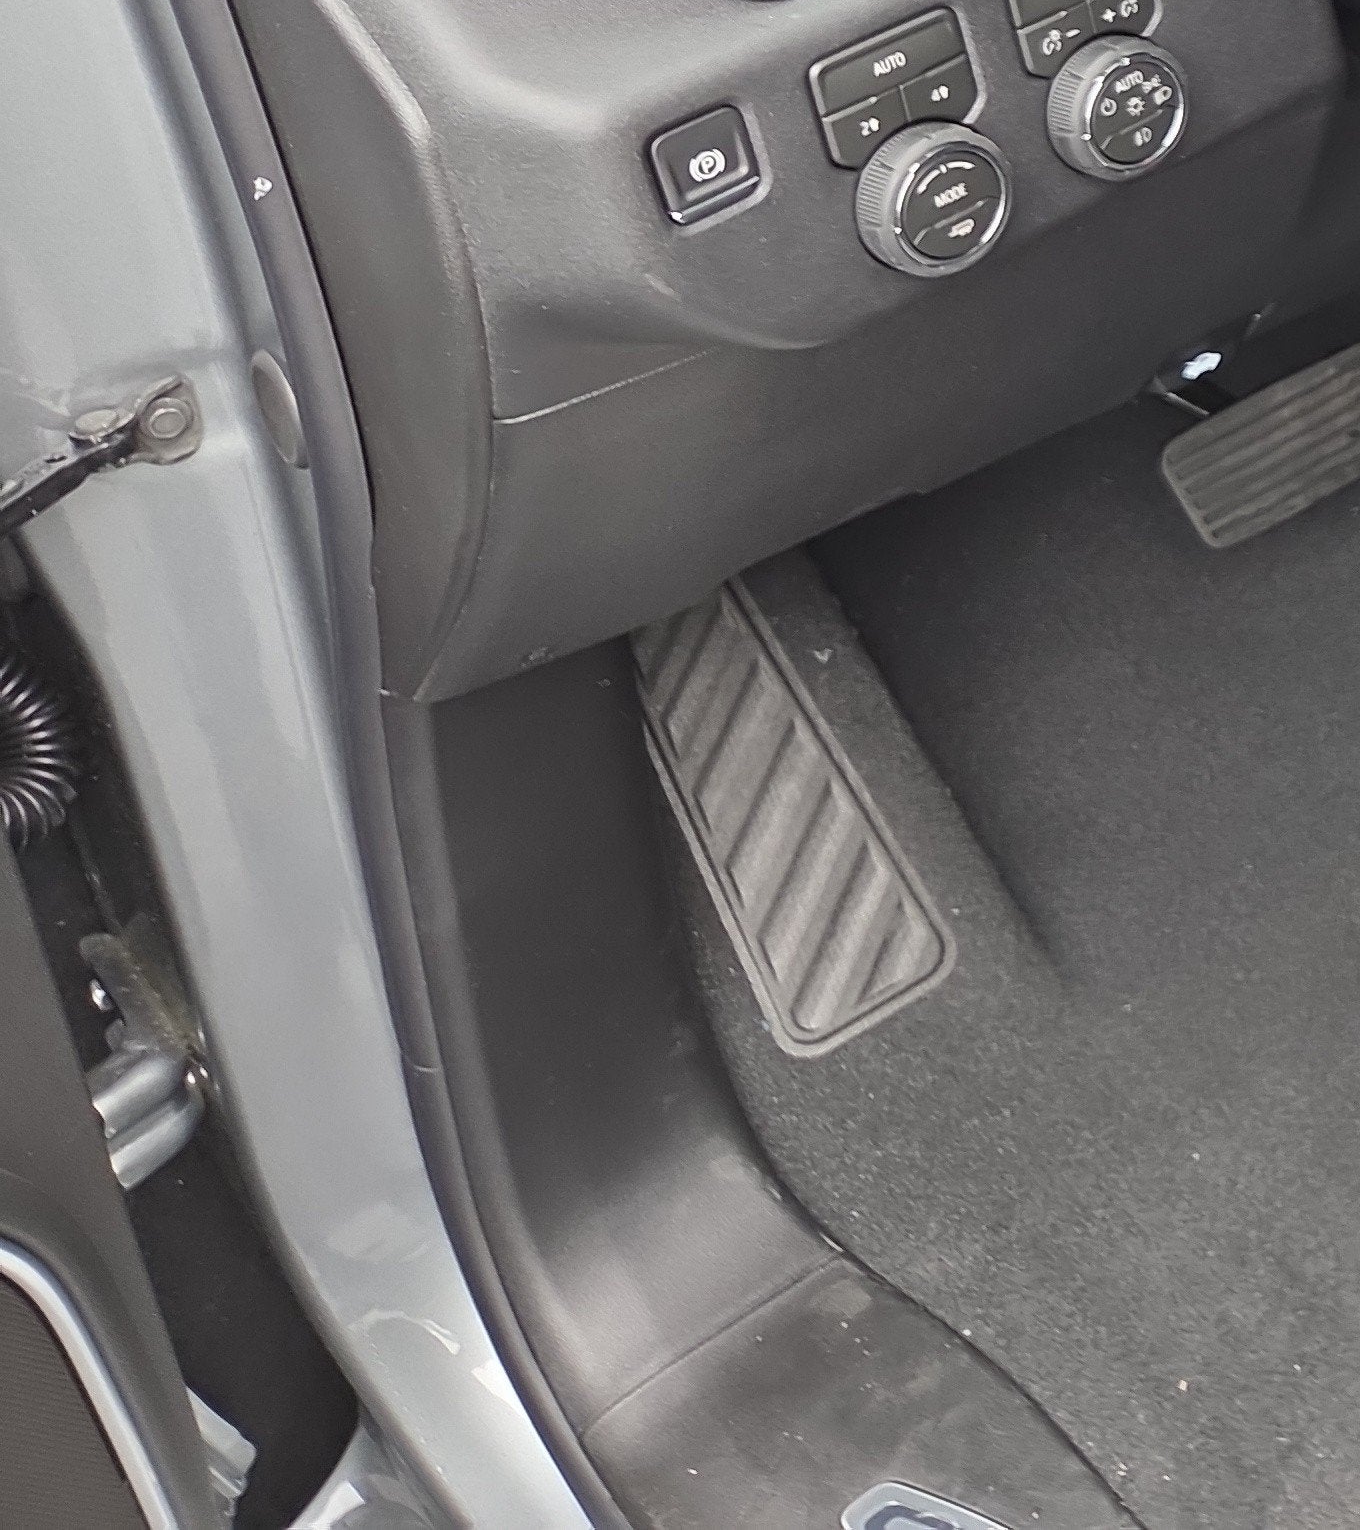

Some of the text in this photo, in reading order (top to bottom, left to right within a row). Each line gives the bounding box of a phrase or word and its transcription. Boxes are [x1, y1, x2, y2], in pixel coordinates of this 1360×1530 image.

[873, 52, 907, 77] AUTO
[1115, 71, 1144, 93] AUTO
[934, 182, 968, 208] MODE
